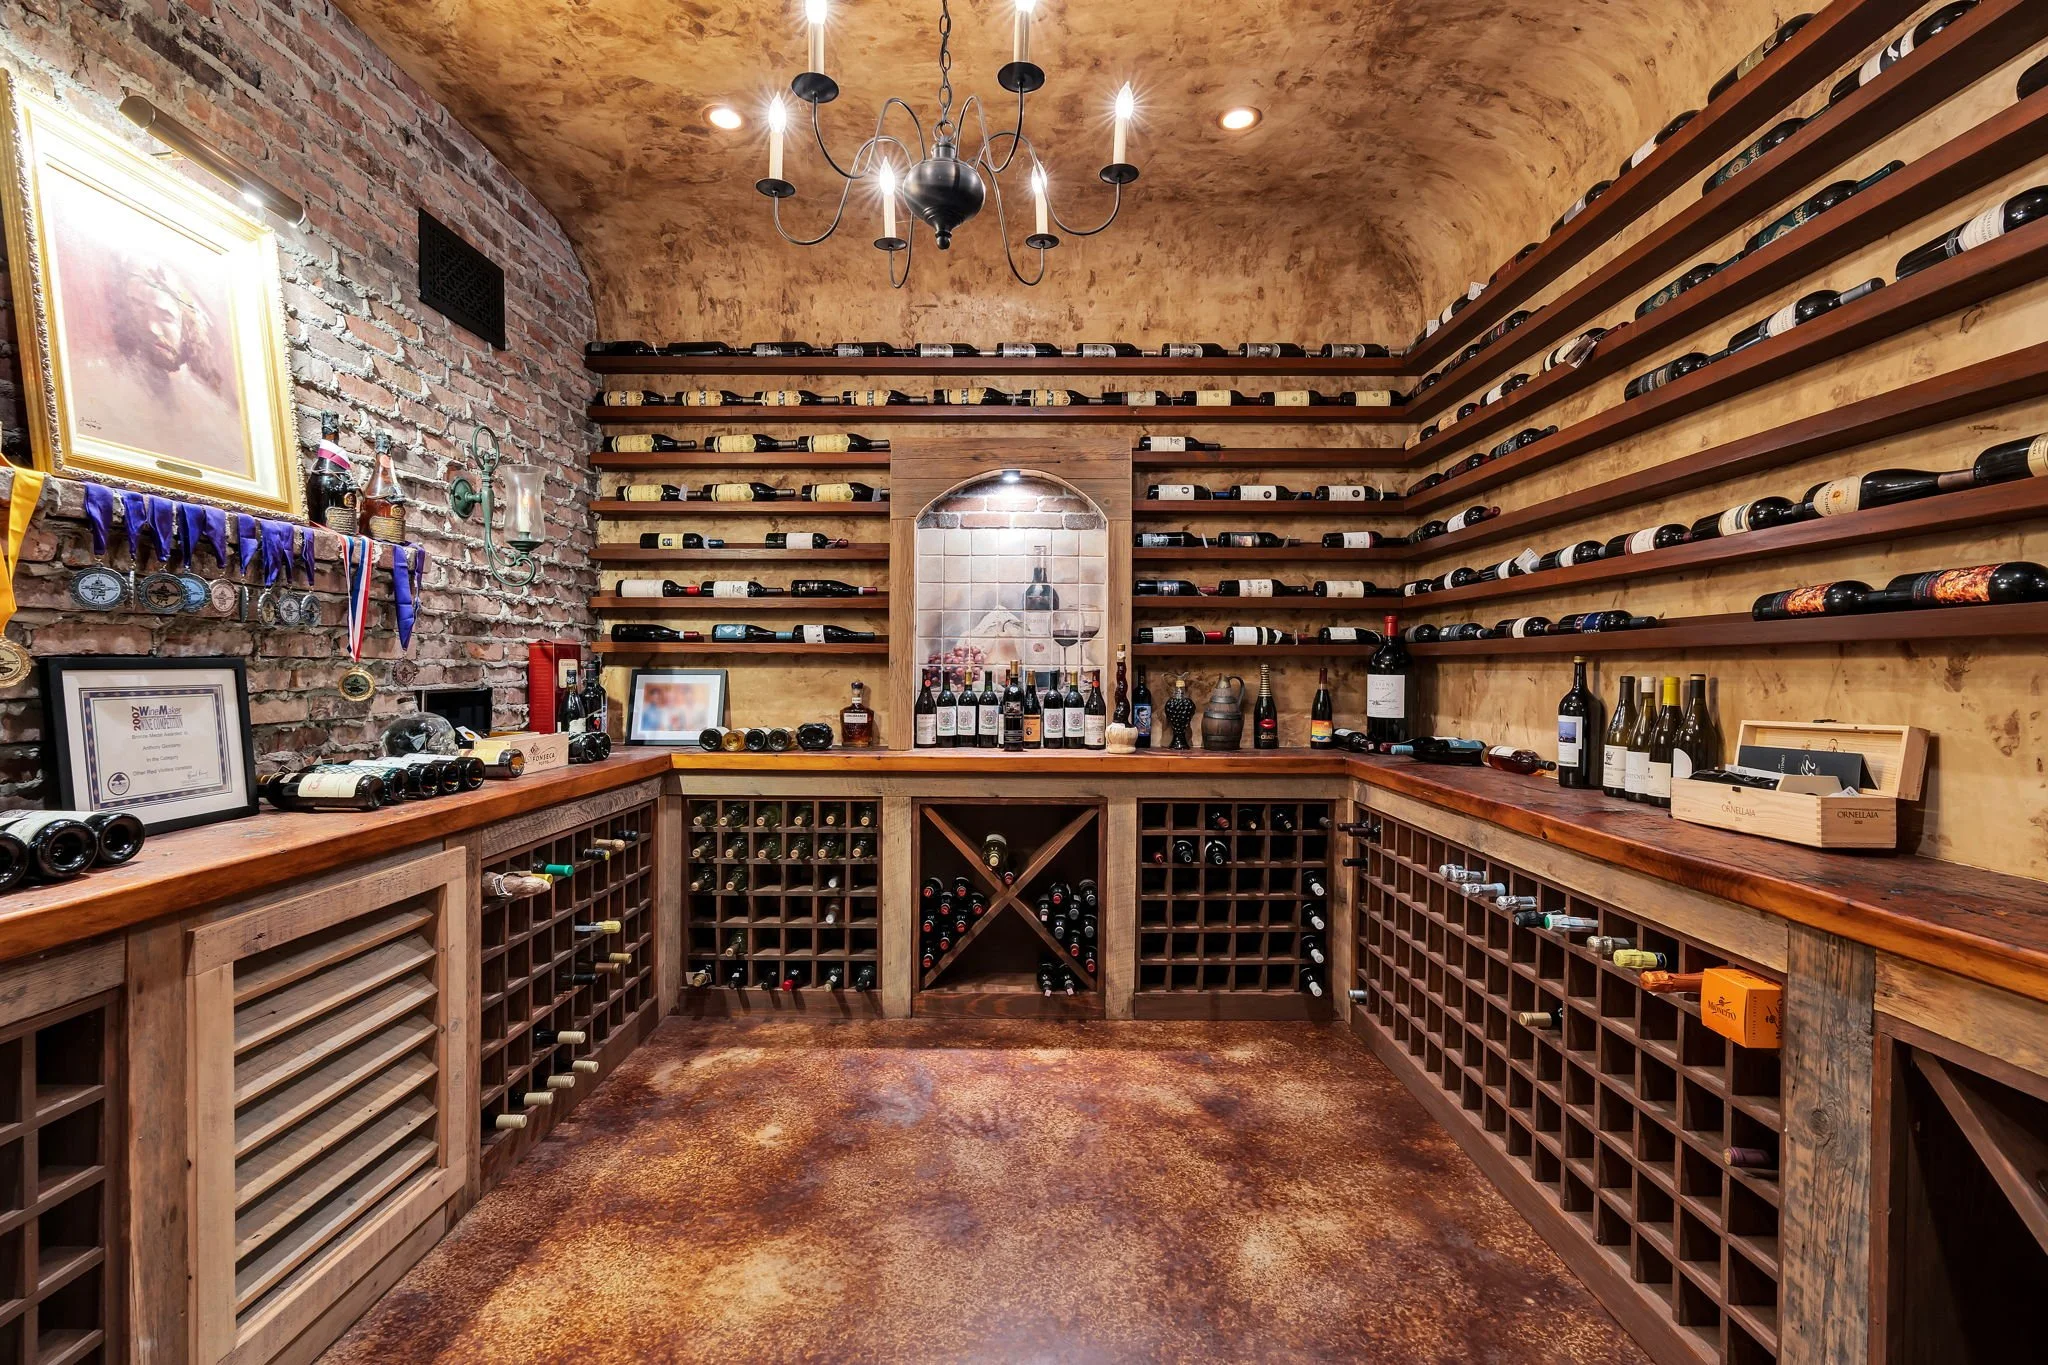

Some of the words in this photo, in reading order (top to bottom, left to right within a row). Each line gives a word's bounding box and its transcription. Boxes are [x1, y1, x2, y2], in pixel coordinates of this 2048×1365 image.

[131, 705, 141, 731] 2007
[532, 752, 555, 762] FONSECA
[1721, 804, 1756, 817] ORNELLAIA
[1837, 810, 1879, 819] ORNELLAIA
